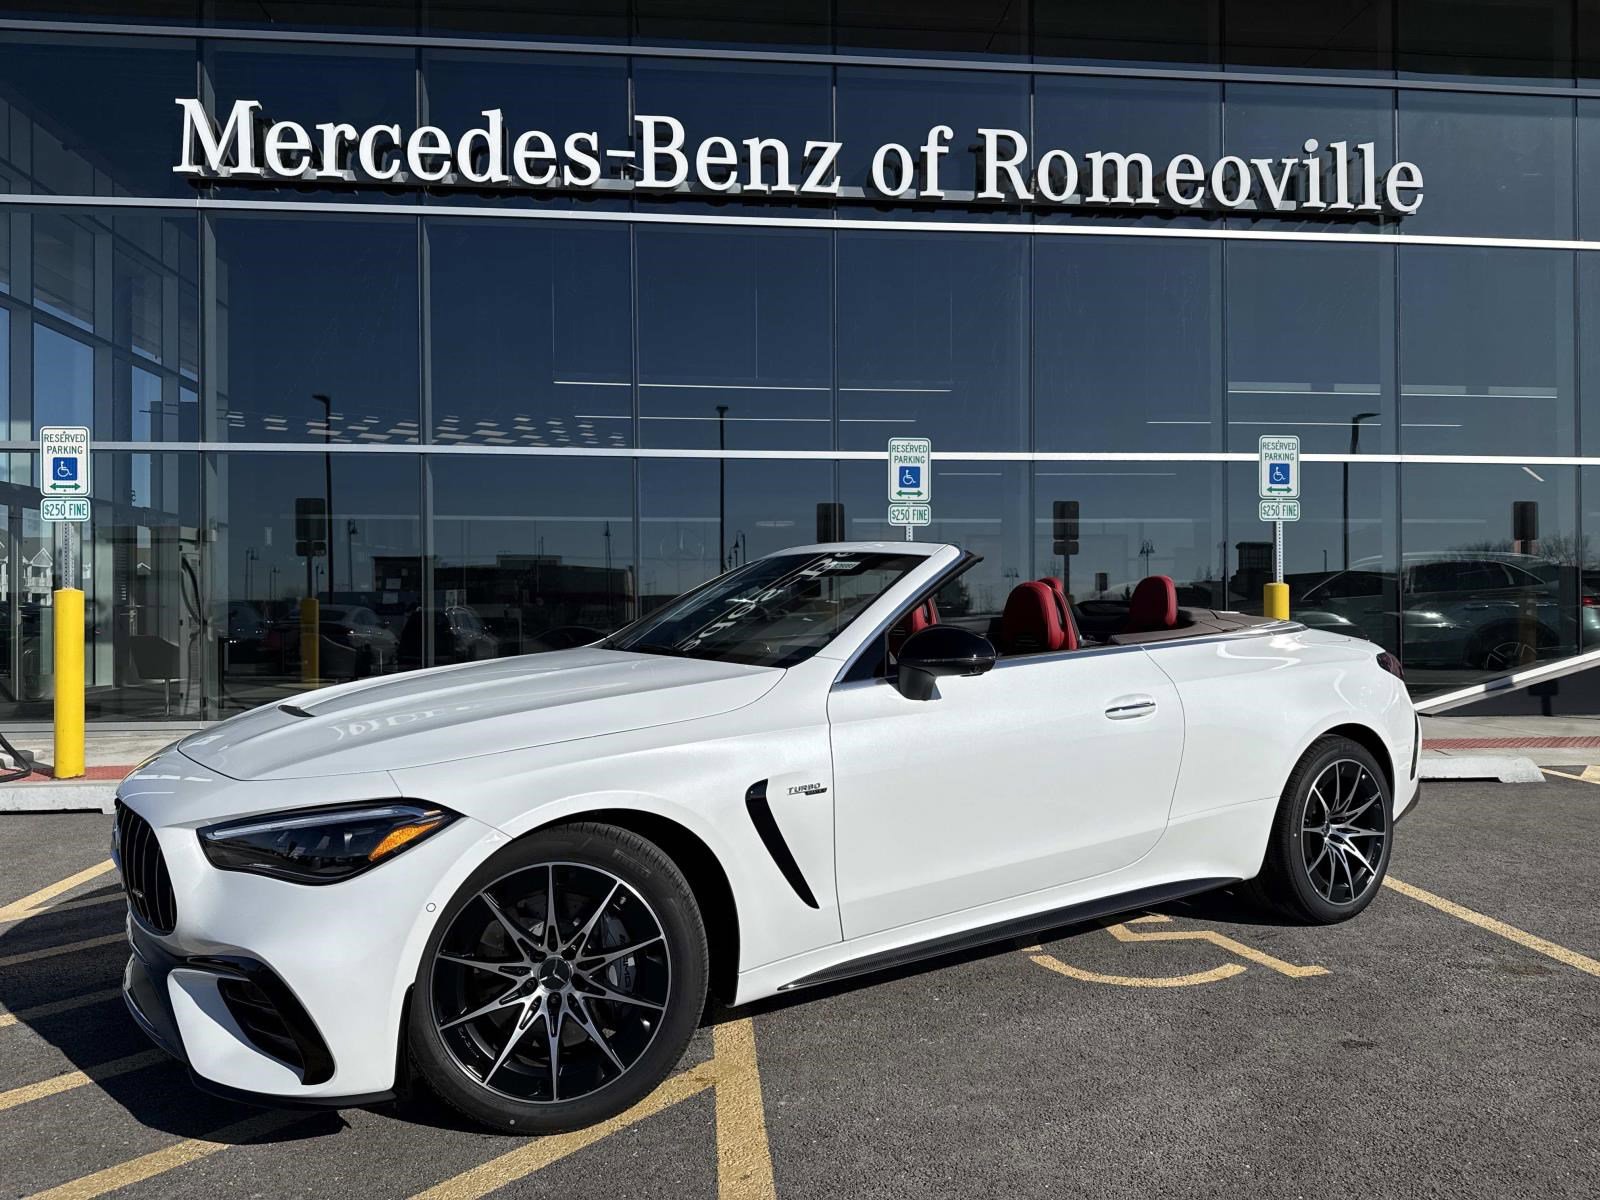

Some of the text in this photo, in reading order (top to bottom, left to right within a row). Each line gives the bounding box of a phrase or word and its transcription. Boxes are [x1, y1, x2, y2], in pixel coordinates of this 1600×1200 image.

[171, 98, 1424, 216] Mercedes-Benz of Romeoville
[43, 433, 85, 443] RESERVED
[47, 445, 83, 455] PARKING
[892, 444, 927, 453] RESERVED
[1262, 442, 1296, 451] RESERVED
[894, 455, 925, 464] PARKING
[1264, 453, 1294, 461] PARKING
[44, 503, 87, 516] $250 FINE
[1262, 504, 1297, 517] $250 FINE
[891, 509, 928, 521] $250 FINE
[788, 782, 821, 795] TURBO
